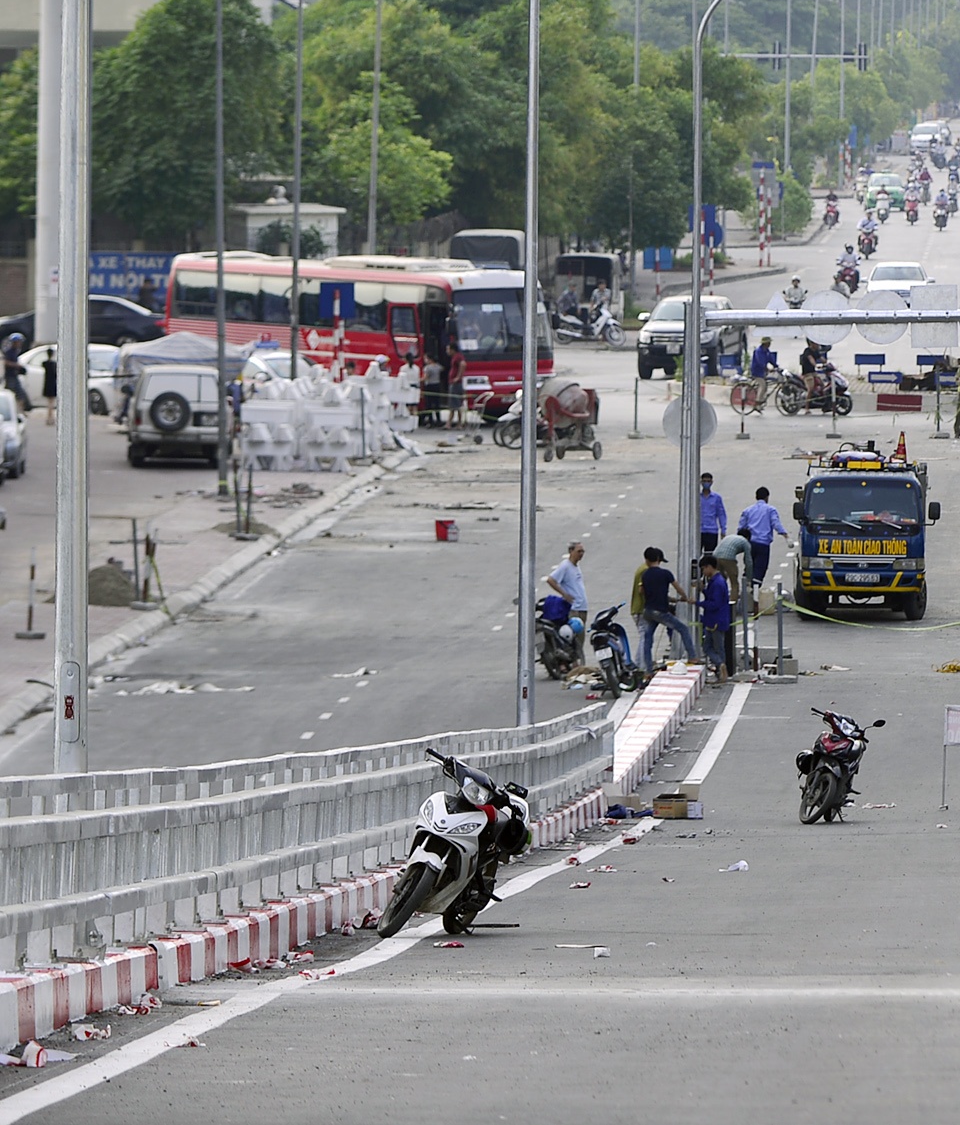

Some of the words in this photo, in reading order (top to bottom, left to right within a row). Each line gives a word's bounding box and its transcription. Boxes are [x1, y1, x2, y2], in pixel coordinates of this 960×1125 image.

[818, 539, 829, 555] XE
[831, 539, 842, 555] AN
[843, 538, 864, 555] TOÀN
[882, 537, 907, 555] THÔNG
